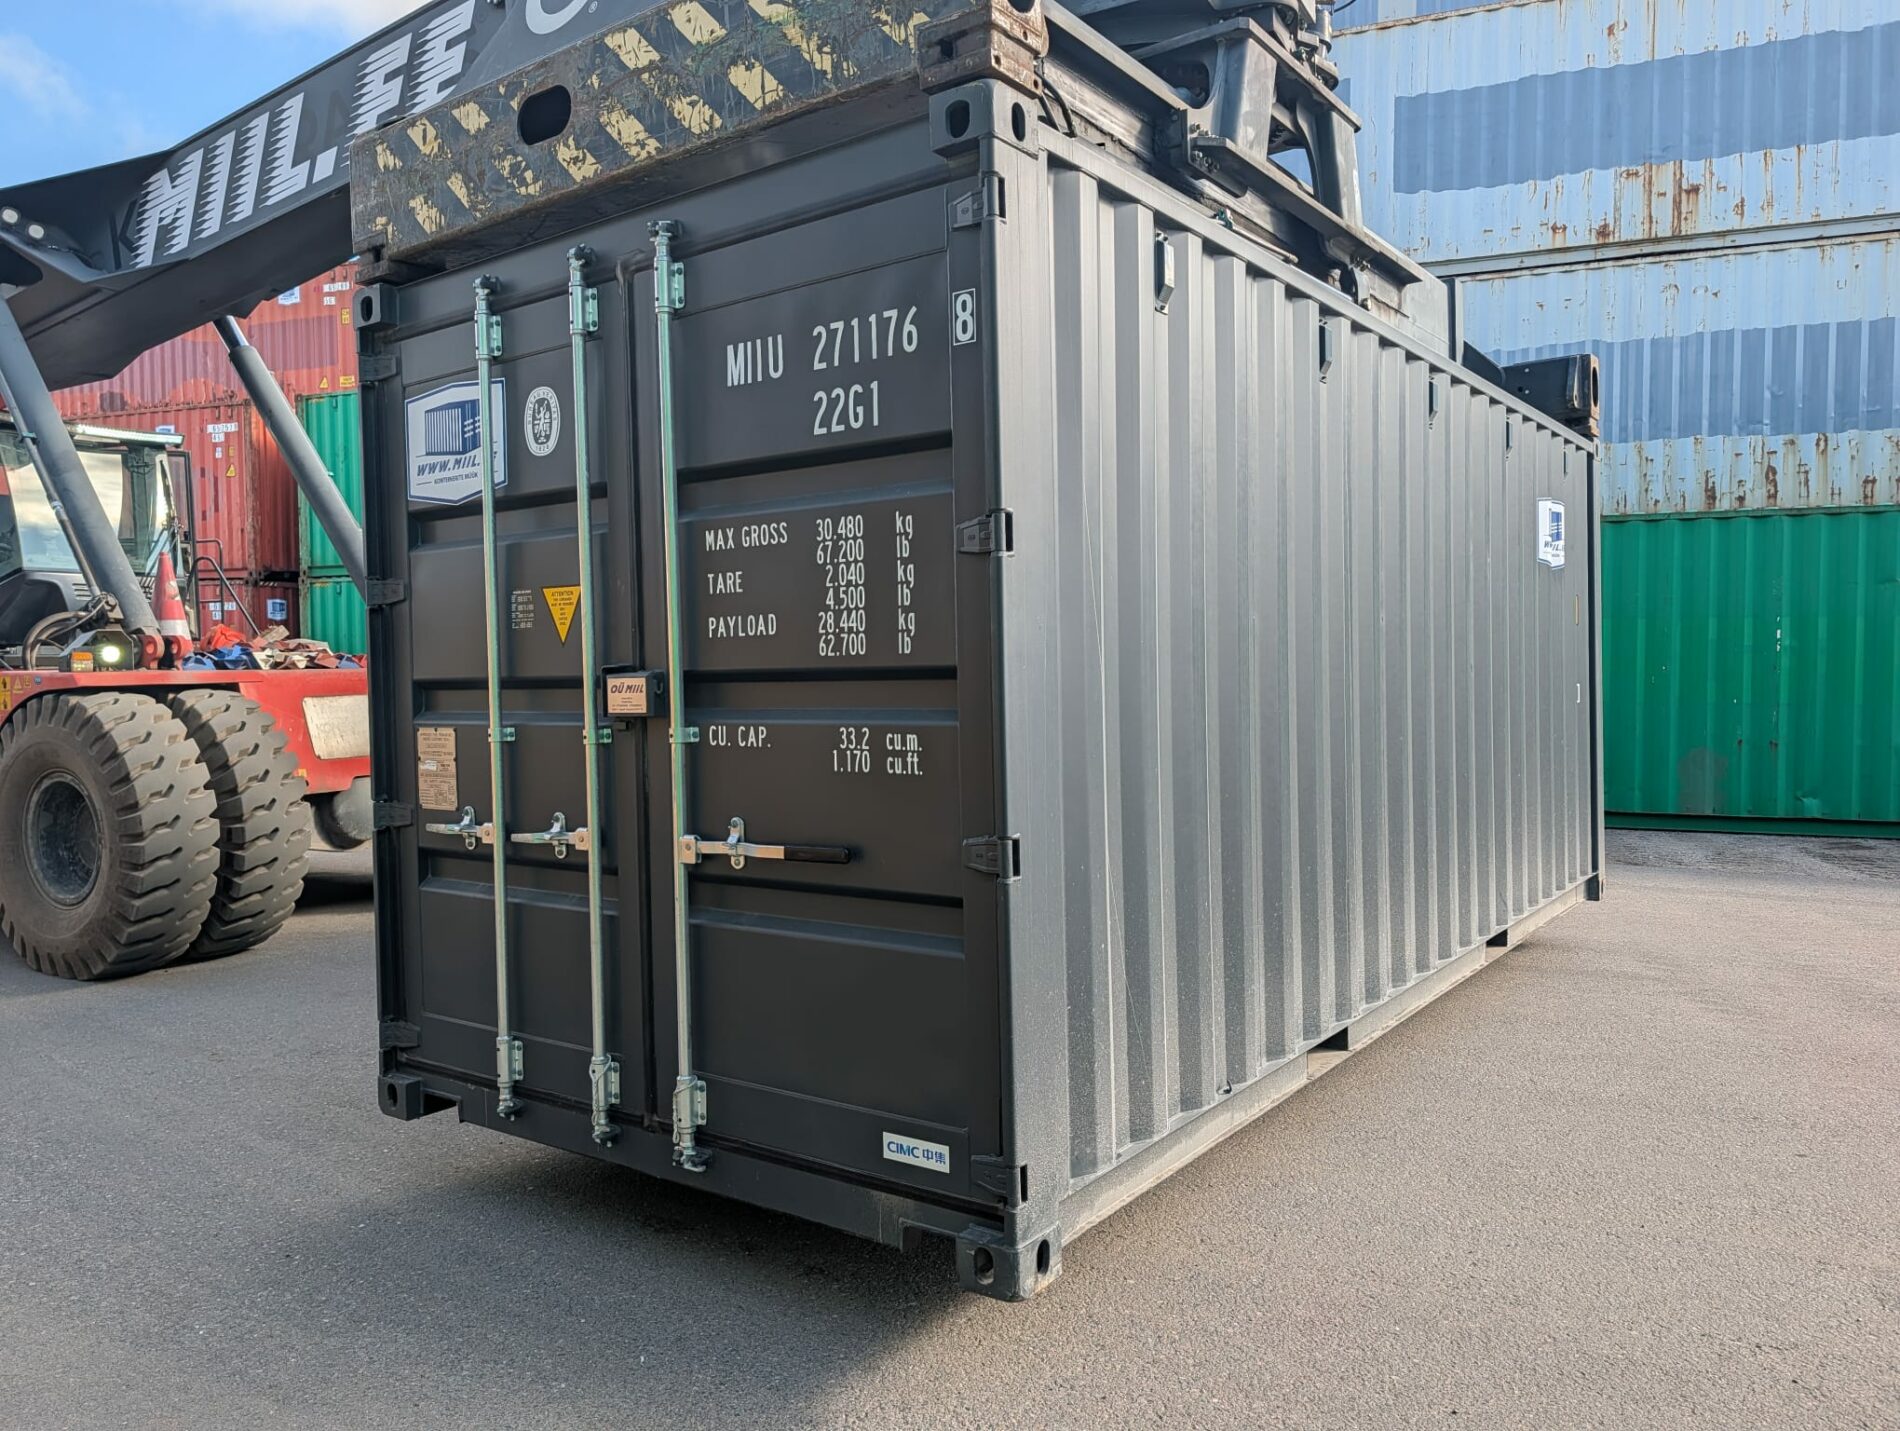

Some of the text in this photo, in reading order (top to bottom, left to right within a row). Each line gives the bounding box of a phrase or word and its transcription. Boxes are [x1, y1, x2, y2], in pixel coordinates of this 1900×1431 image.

[726, 292, 974, 387] MIIU 271176 8
[813, 380, 880, 436] 22G1
[416, 452, 497, 476] WWW.MIIL.
[705, 511, 913, 551] MAX GROSS 30.480 kg
[816, 535, 910, 565] 67.200 lb
[708, 560, 915, 595] TARE 2.040 kg
[825, 583, 911, 610] 4.500 lb
[709, 608, 916, 638] PAYLOAD 28.440 kg
[818, 632, 912, 657] 62.700 lb
[610, 682, 644, 693] OÜ MIIL
[709, 725, 922, 751] CU. CAP. 33.2 cu.m.
[832, 750, 923, 775] 1.170 cu.ft.
[887, 1140, 946, 1165] CIMC 中集
